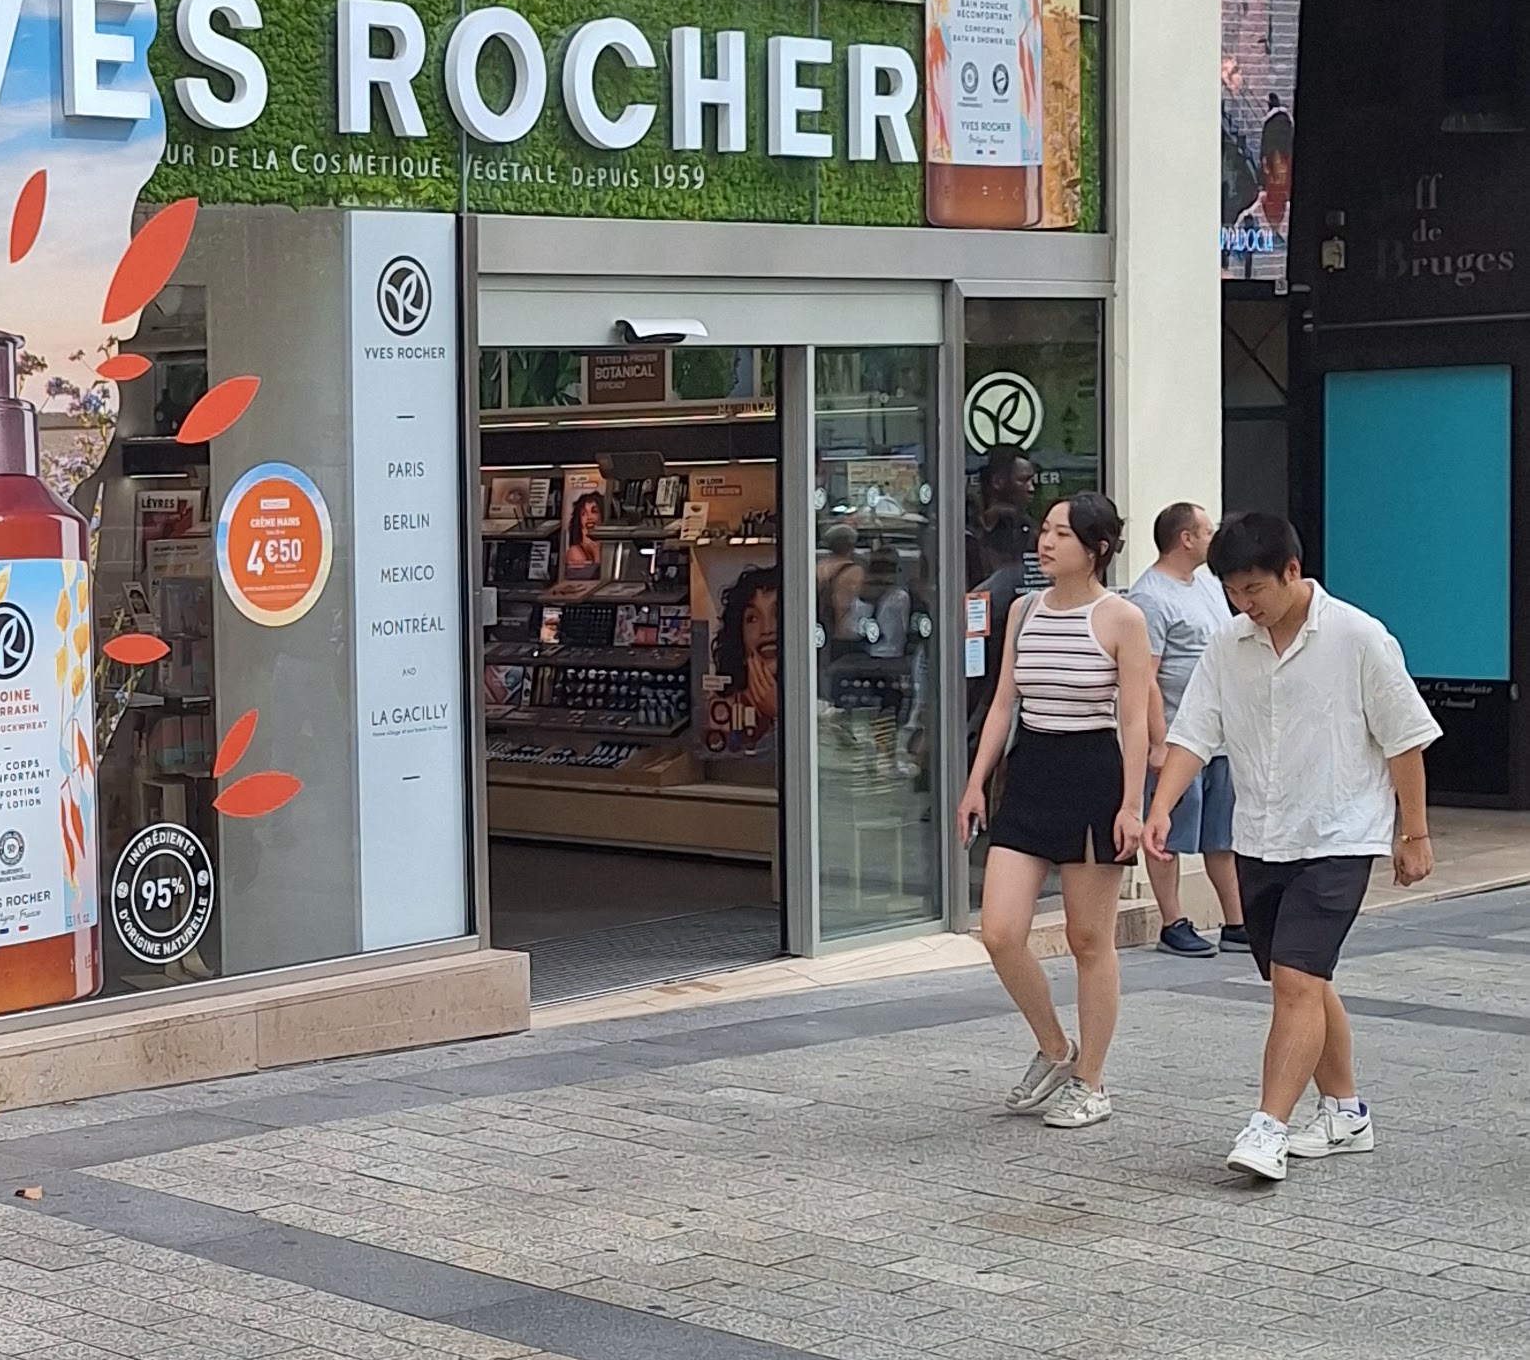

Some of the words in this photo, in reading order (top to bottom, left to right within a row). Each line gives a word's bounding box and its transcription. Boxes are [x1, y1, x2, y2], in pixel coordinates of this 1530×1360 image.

[157, 143, 195, 166] UR
[210, 145, 240, 169] DE
[252, 148, 280, 172] LA
[653, 163, 706, 190] 1959
[1411, 218, 1443, 243] de
[1375, 239, 1515, 287] Bruges
[364, 347, 394, 359] YVES
[397, 347, 446, 359] ROCHER
[594, 363, 656, 380] BOTANICAL
[387, 461, 425, 479] PARIS
[141, 495, 175, 509] LÈVRES
[383, 513, 430, 531] BERLIN
[380, 565, 435, 583] MEXICO
[371, 614, 445, 637] MONTRÉAL
[371, 710, 389, 726] LA
[392, 703, 448, 724] GACILLY
[6, 759, 40, 771] CORPS
[7, 798, 42, 809] LOTION
[127, 830, 196, 866] INGRÉDIENTS
[6, 890, 51, 907] ROCHER
[141, 876, 186, 911] 95%
[163, 896, 209, 956] NATURELLE
